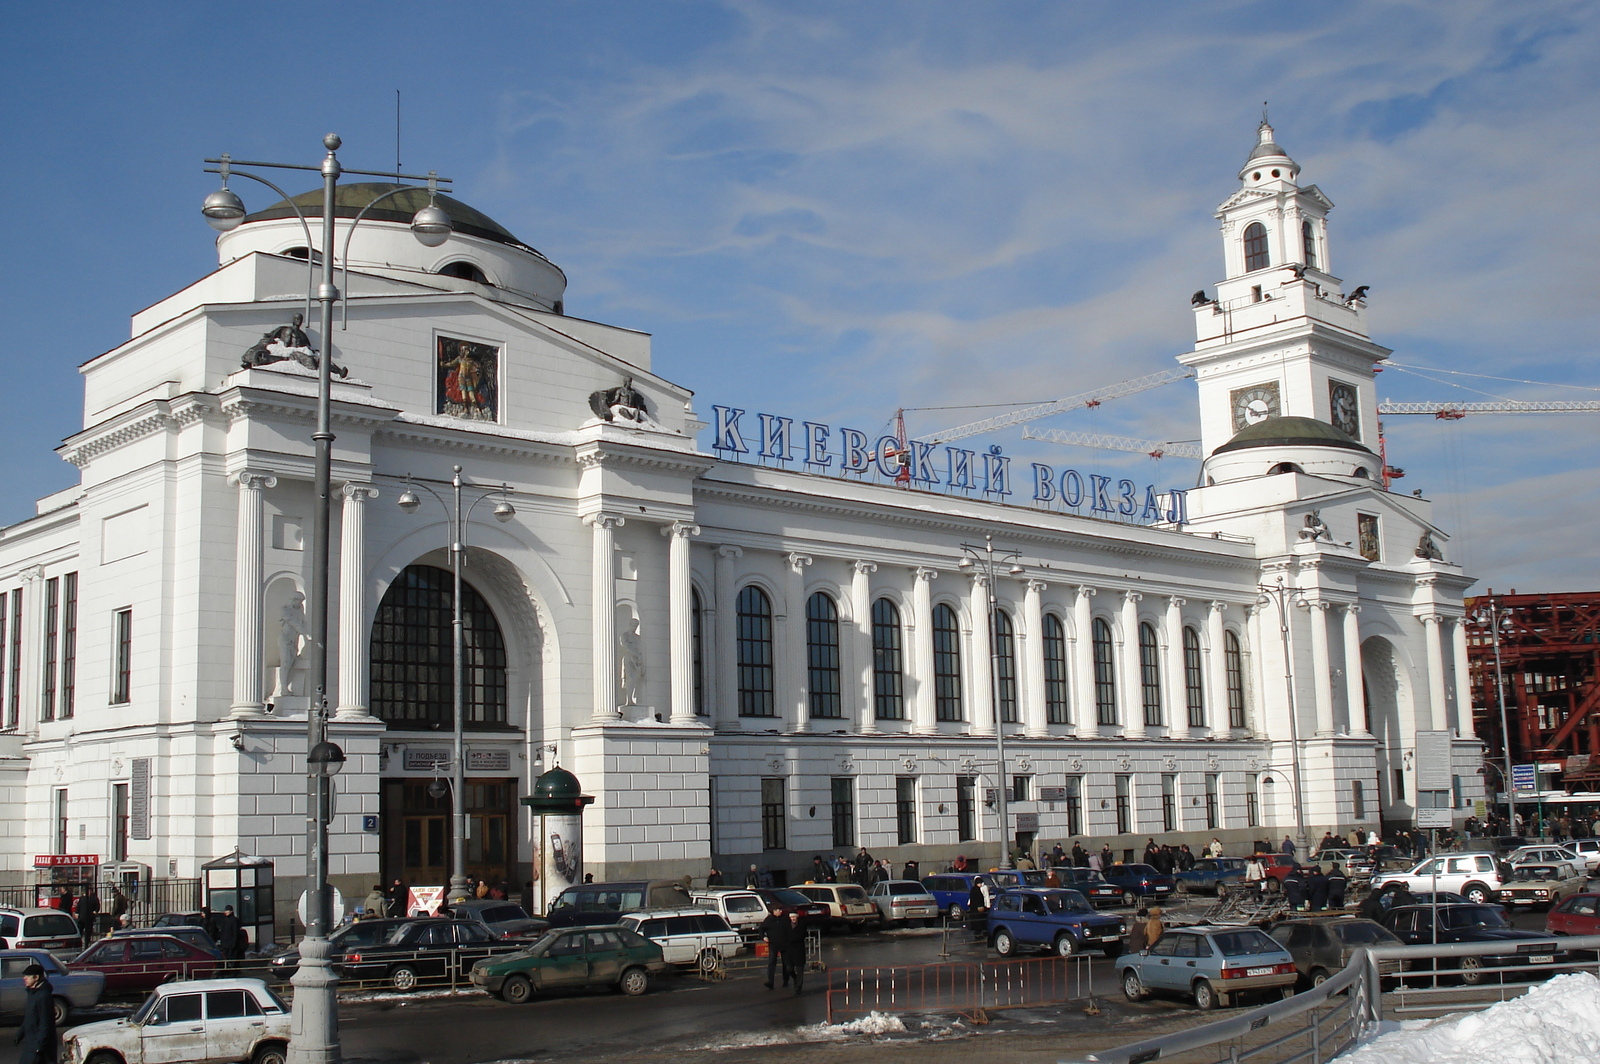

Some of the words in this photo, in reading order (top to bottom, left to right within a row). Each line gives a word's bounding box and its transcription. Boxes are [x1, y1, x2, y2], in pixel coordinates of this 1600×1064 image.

[712, 404, 1012, 495] КИЕВСКИЙ
[1031, 462, 1190, 525] ВОКЗАЛ
[368, 818, 374, 828] 2
[56, 856, 95, 864] ТАБАК
